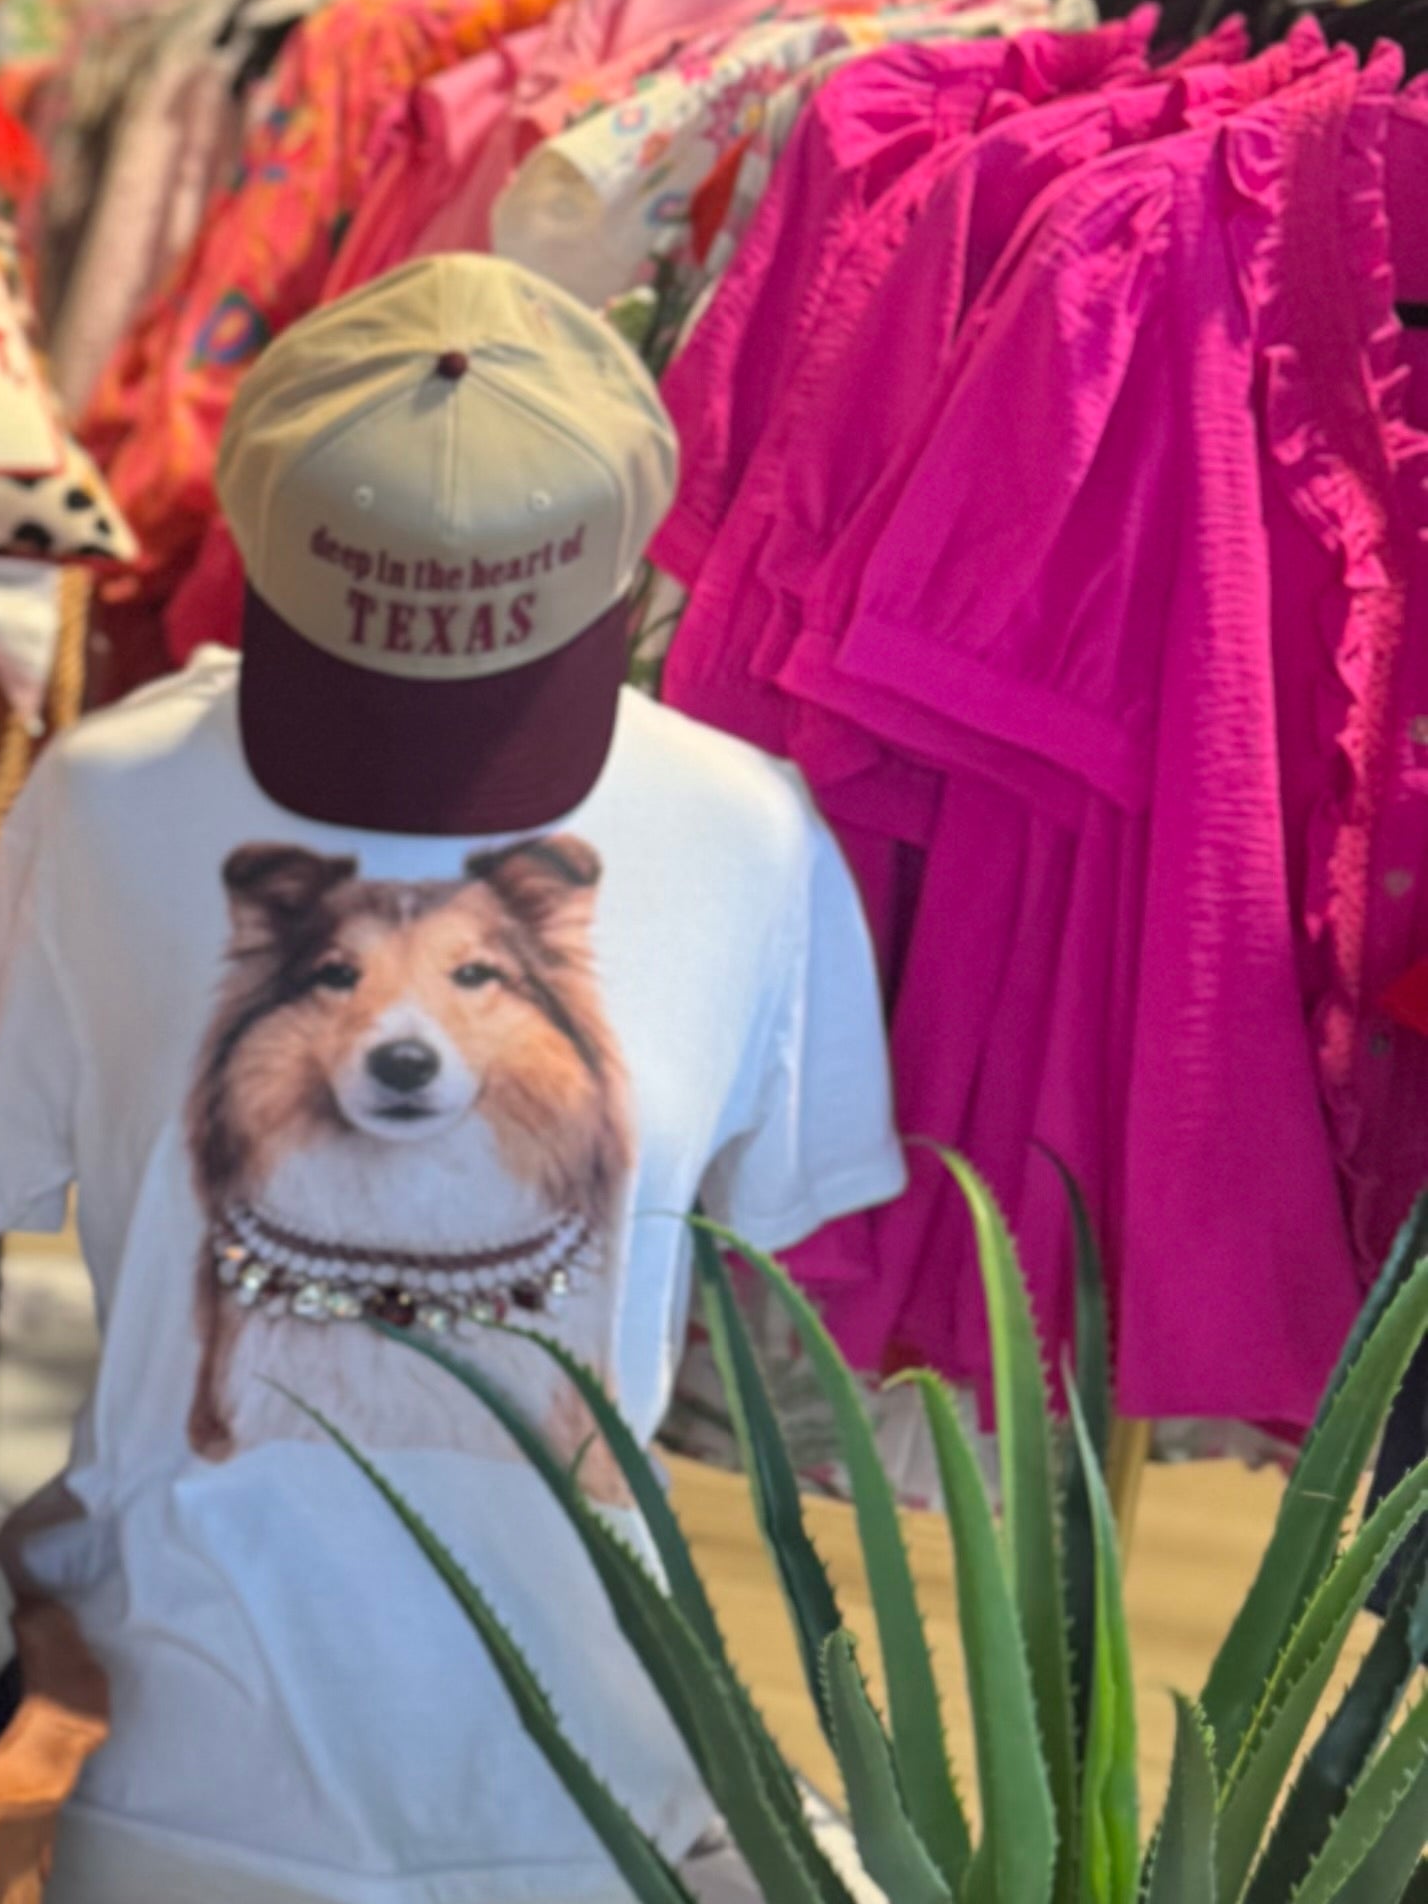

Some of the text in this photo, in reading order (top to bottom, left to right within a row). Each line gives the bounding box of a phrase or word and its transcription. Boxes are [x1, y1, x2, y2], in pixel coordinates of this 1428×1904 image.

[310, 524, 373, 582] deep
[375, 548, 407, 587] in
[412, 556, 465, 591] the
[470, 540, 554, 591] heart
[345, 586, 540, 656] TEXAS
